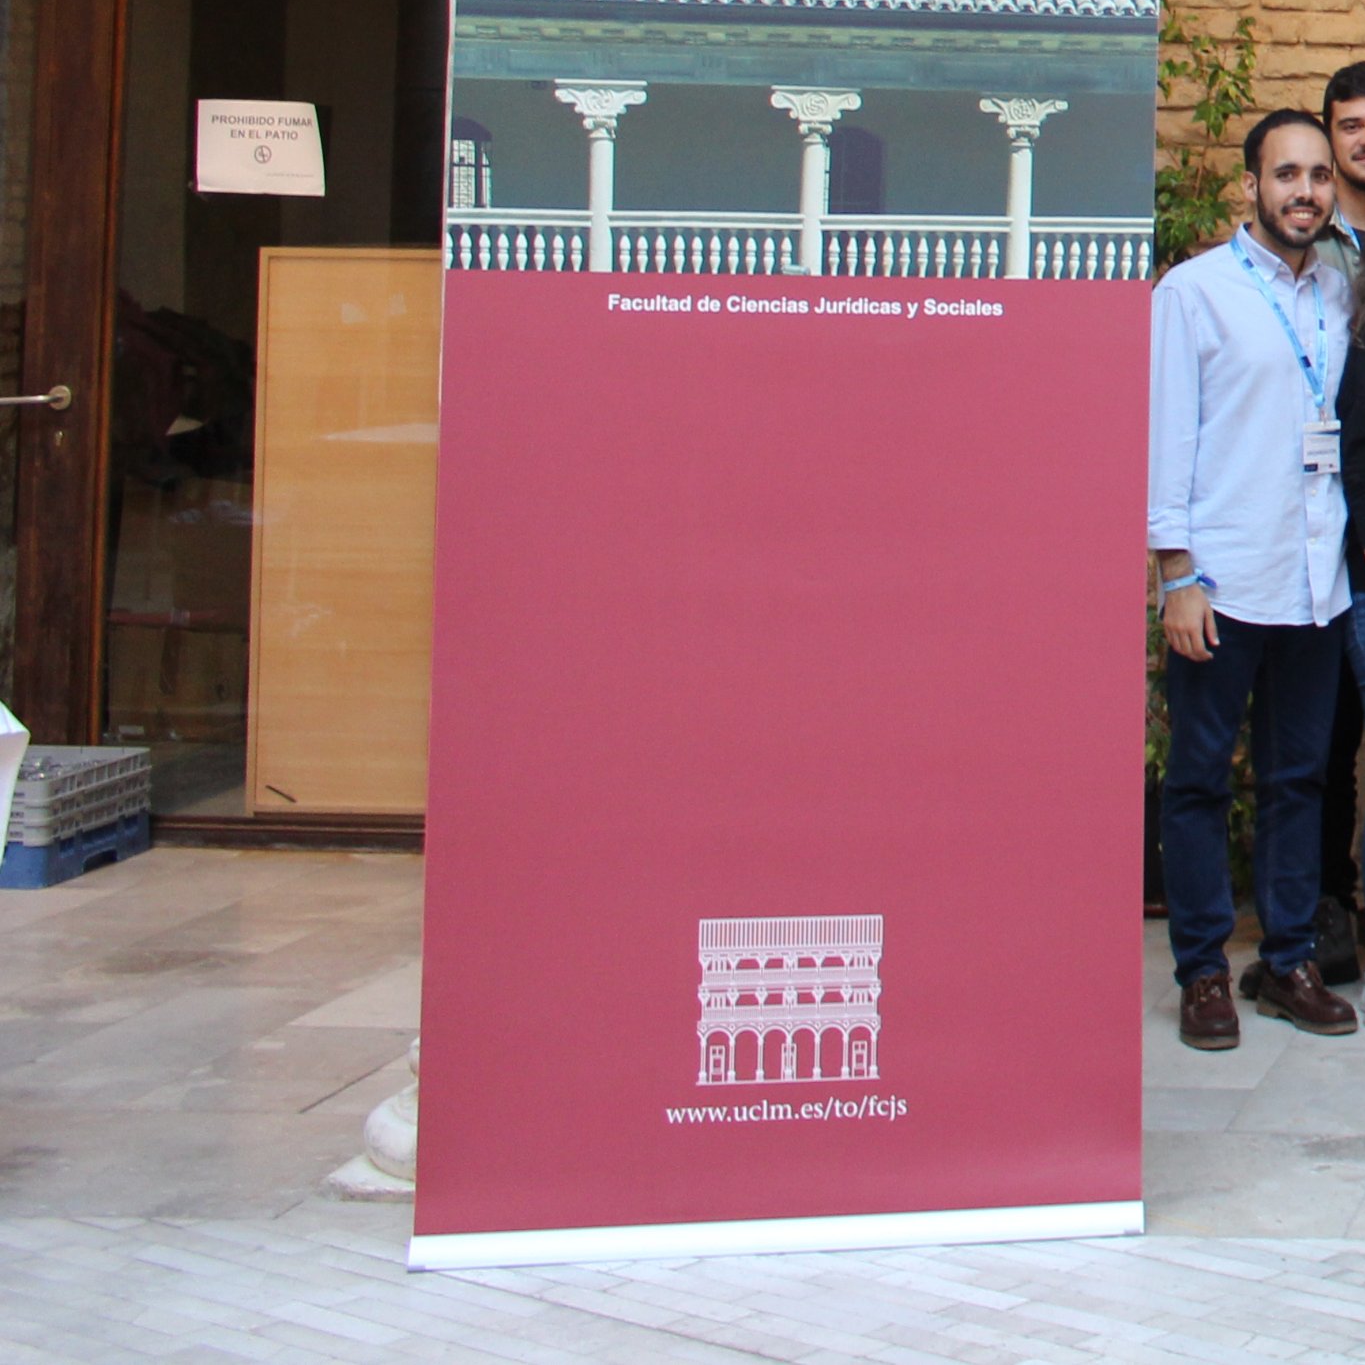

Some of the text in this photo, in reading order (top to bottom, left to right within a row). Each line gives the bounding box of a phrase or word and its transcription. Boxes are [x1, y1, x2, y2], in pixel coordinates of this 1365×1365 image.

[211, 114, 313, 128] PROHIBIDO FUMAR
[230, 129, 298, 141] EN EL PATIO
[608, 294, 1004, 319] Facultad de Ciencias Jurídicas y Sociales
[665, 1095, 908, 1124] www.uclm.es/to/fcjs
